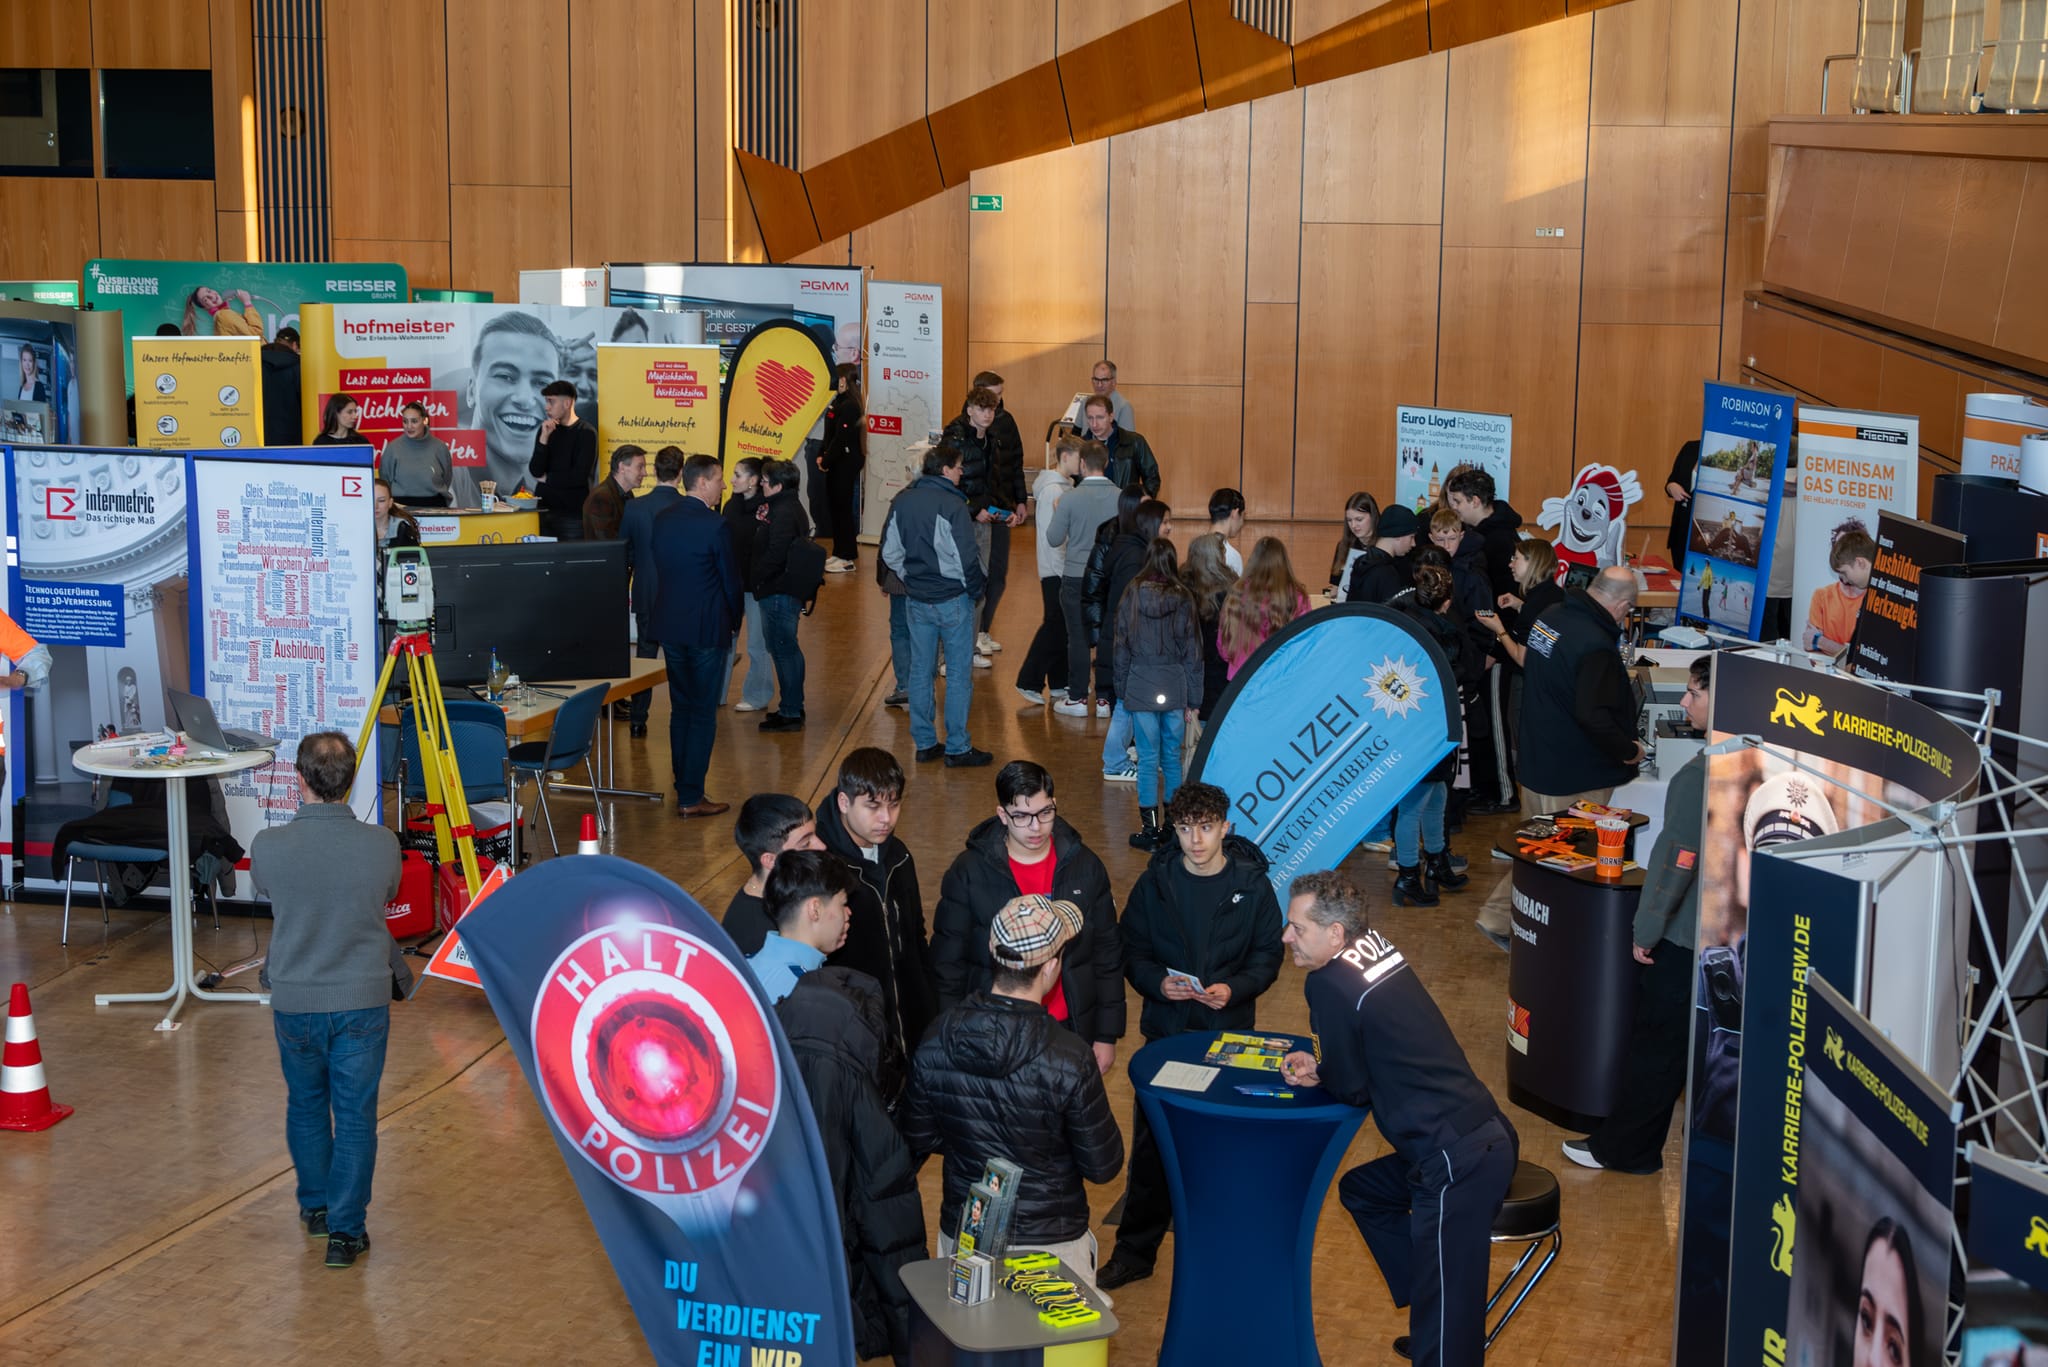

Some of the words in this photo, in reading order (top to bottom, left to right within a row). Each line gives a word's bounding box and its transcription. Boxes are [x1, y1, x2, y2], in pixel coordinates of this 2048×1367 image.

[98, 276, 159, 286] AUSBILDUNG
[325, 279, 396, 292] REISSER
[800, 280, 849, 291] PGMM
[97, 285, 159, 295] BEIREISSER
[904, 292, 934, 302] PGMM
[343, 318, 456, 334] hofmeister
[876, 319, 900, 328] 400
[917, 326, 930, 336] 19
[142, 353, 169, 363] Unsere
[345, 373, 368, 386] Lass
[371, 374, 389, 386] aus
[392, 372, 425, 385] deinen
[1721, 396, 1771, 417] ROBINSON
[617, 415, 697, 434] Ausbildungsberufe
[1401, 411, 1426, 425] Euro
[1428, 414, 1456, 429] Lloyd
[1457, 416, 1506, 433] Reisebüro
[738, 420, 783, 445] Ausbildung
[737, 440, 783, 456] hofmeister
[1804, 455, 1895, 481] GEMEINSAM
[245, 483, 264, 498] Gleis
[1803, 475, 1833, 494] GAS
[1838, 479, 1893, 502] GEBEN!
[86, 487, 155, 514] intermetric
[266, 495, 299, 509] Innovation
[1814, 495, 1839, 505] HELMUT
[1840, 498, 1866, 509] FISCHER
[86, 513, 101, 522] Das
[103, 513, 136, 525] richtige
[138, 515, 155, 525] Maß
[311, 507, 327, 558] intermetric
[418, 525, 457, 533] meister
[237, 542, 313, 556] Bestandsdokumentation
[262, 555, 275, 571] Wir
[276, 556, 302, 572] sichern
[303, 557, 329, 573] Zukunft
[1873, 547, 1921, 585] Ausbildun
[25, 584, 100, 597] TECHNOLOGIEFÜHRER
[271, 569, 285, 611] Mitarbeiter
[285, 574, 298, 617] Geotechnik
[51, 596, 113, 608] 3D-VERMESSUNG
[264, 614, 310, 629] Geoinformatik
[239, 623, 314, 639] Ingenieurvermessung
[219, 637, 249, 653] Beratung
[262, 638, 275, 659] Trasse
[274, 639, 325, 663] Ausbildung
[334, 628, 347, 661] Techniker
[248, 639, 261, 682] Vermessung
[209, 670, 233, 684] Chancen
[288, 673, 301, 726] Dokumentation
[1235, 694, 1360, 827] POLIZEI
[224, 783, 259, 800] Sicherung
[287, 785, 301, 800] Das
[1327, 749, 1403, 829] LUDWIGSBURG
[1266, 733, 1391, 869] N-WÜRTTEMBERG
[385, 902, 412, 913] eica
[556, 932, 699, 1003] HALT
[1780, 914, 1811, 1186] KARRIERE-POLIZEI-BW.DE
[580, 1096, 770, 1192] POLIZEI
[664, 1259, 698, 1293] DU
[676, 1298, 821, 1345] VERDIENST
[697, 1340, 741, 1367] EIN
